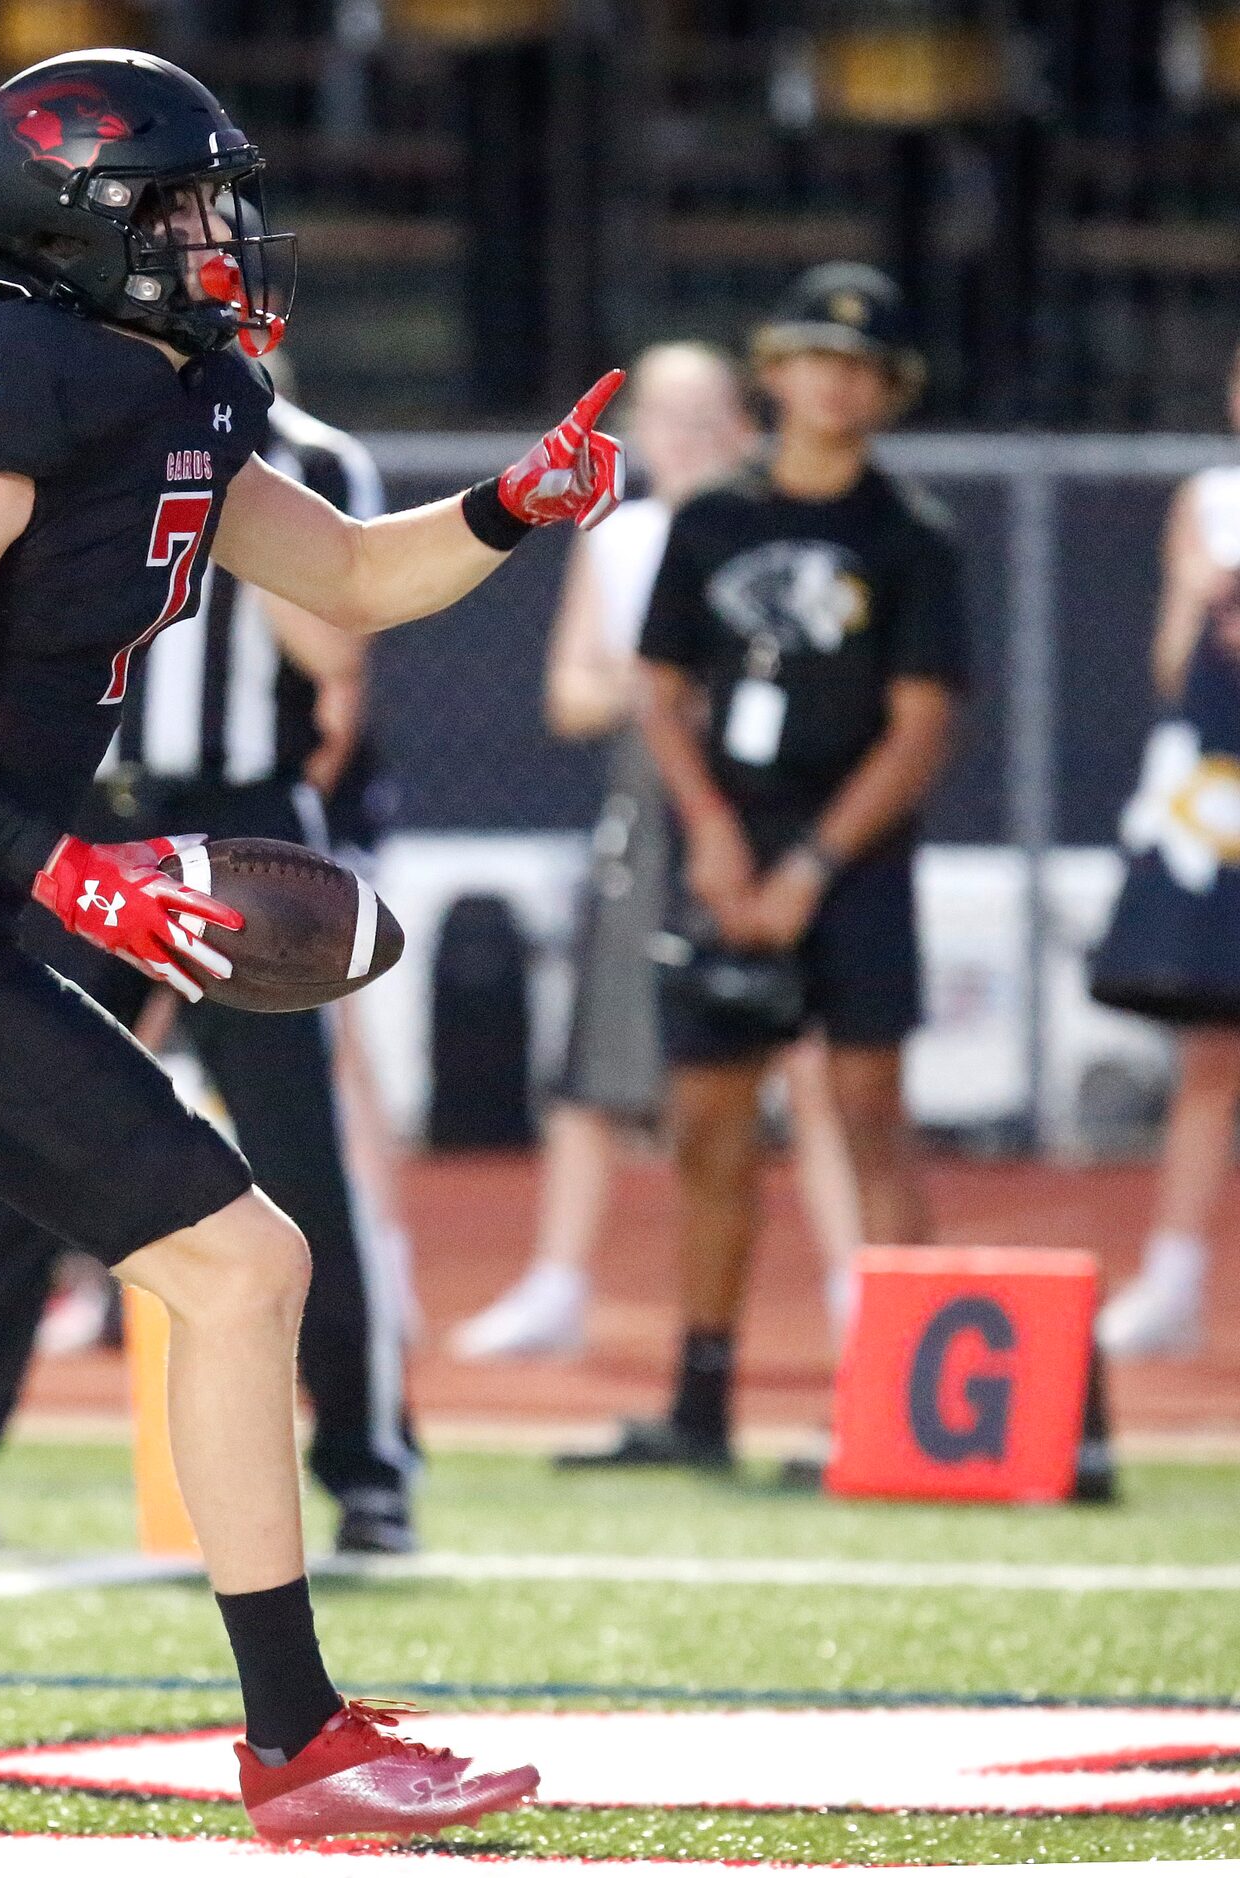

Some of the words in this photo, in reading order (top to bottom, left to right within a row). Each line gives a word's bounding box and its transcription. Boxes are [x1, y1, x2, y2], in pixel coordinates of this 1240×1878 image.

[167, 450, 213, 481] CARDS
[97, 490, 213, 705] 7
[910, 1294, 1016, 1464] G
